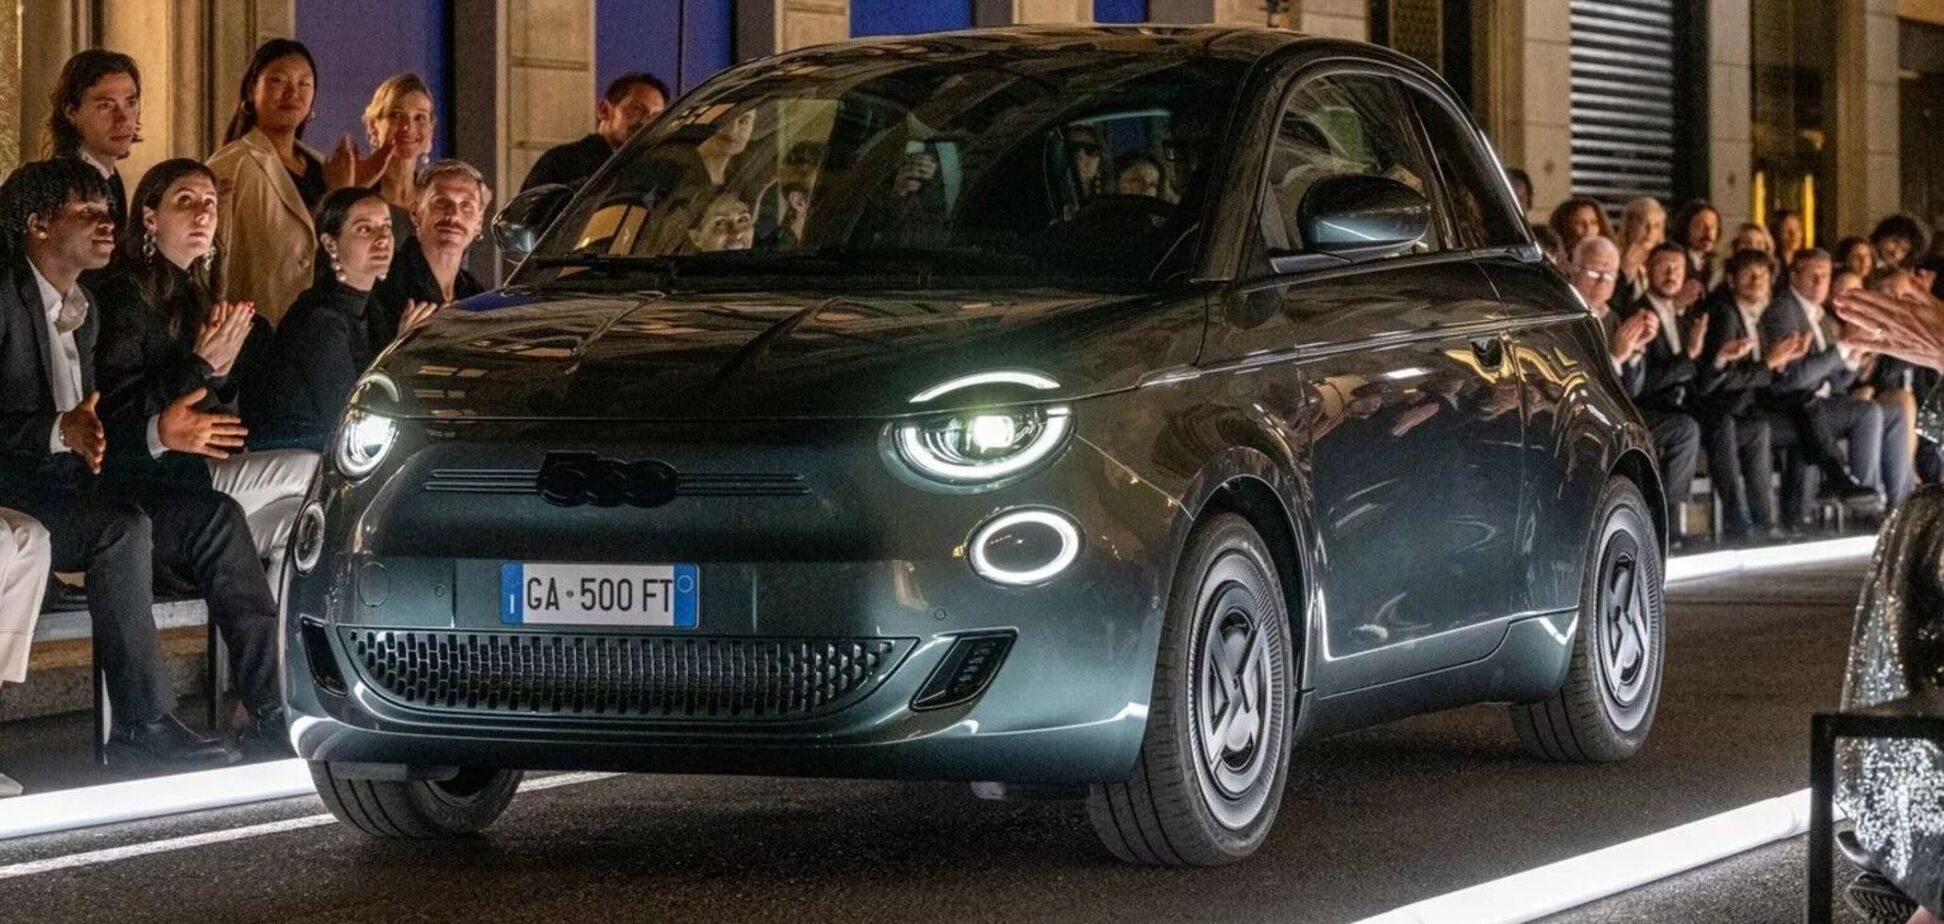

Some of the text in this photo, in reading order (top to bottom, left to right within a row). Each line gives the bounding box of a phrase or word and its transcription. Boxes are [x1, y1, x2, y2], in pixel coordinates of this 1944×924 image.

[536, 450, 680, 508] 500
[527, 577, 673, 613] GA 500 FT
